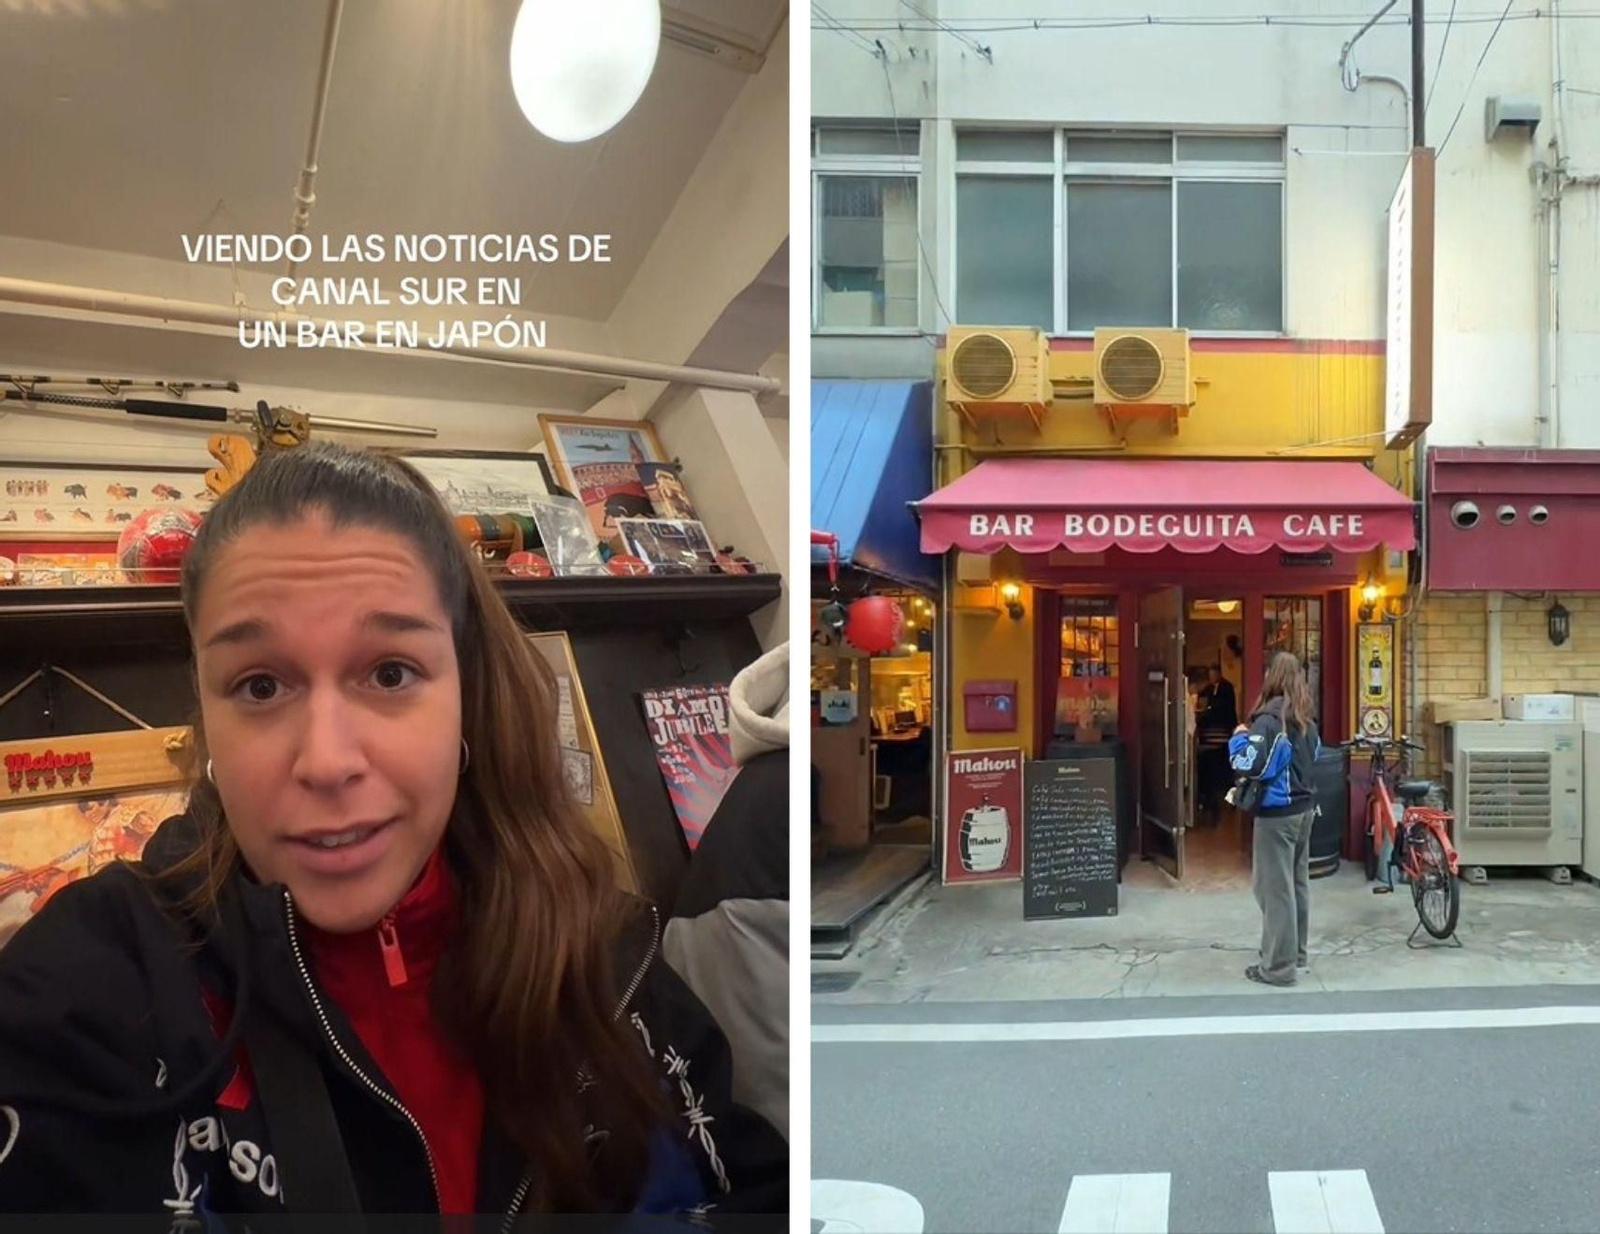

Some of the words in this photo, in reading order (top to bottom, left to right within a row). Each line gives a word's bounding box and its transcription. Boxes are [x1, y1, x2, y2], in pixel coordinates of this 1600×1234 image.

[969, 514, 1034, 537] BAR
[1064, 514, 1256, 537] BODEGUITA
[1283, 513, 1365, 536] CAFE
[645, 695, 729, 718] DIAMO
[4, 749, 92, 770] Mahou
[953, 757, 1017, 774] Mahou
[969, 835, 1001, 846] Mahou
